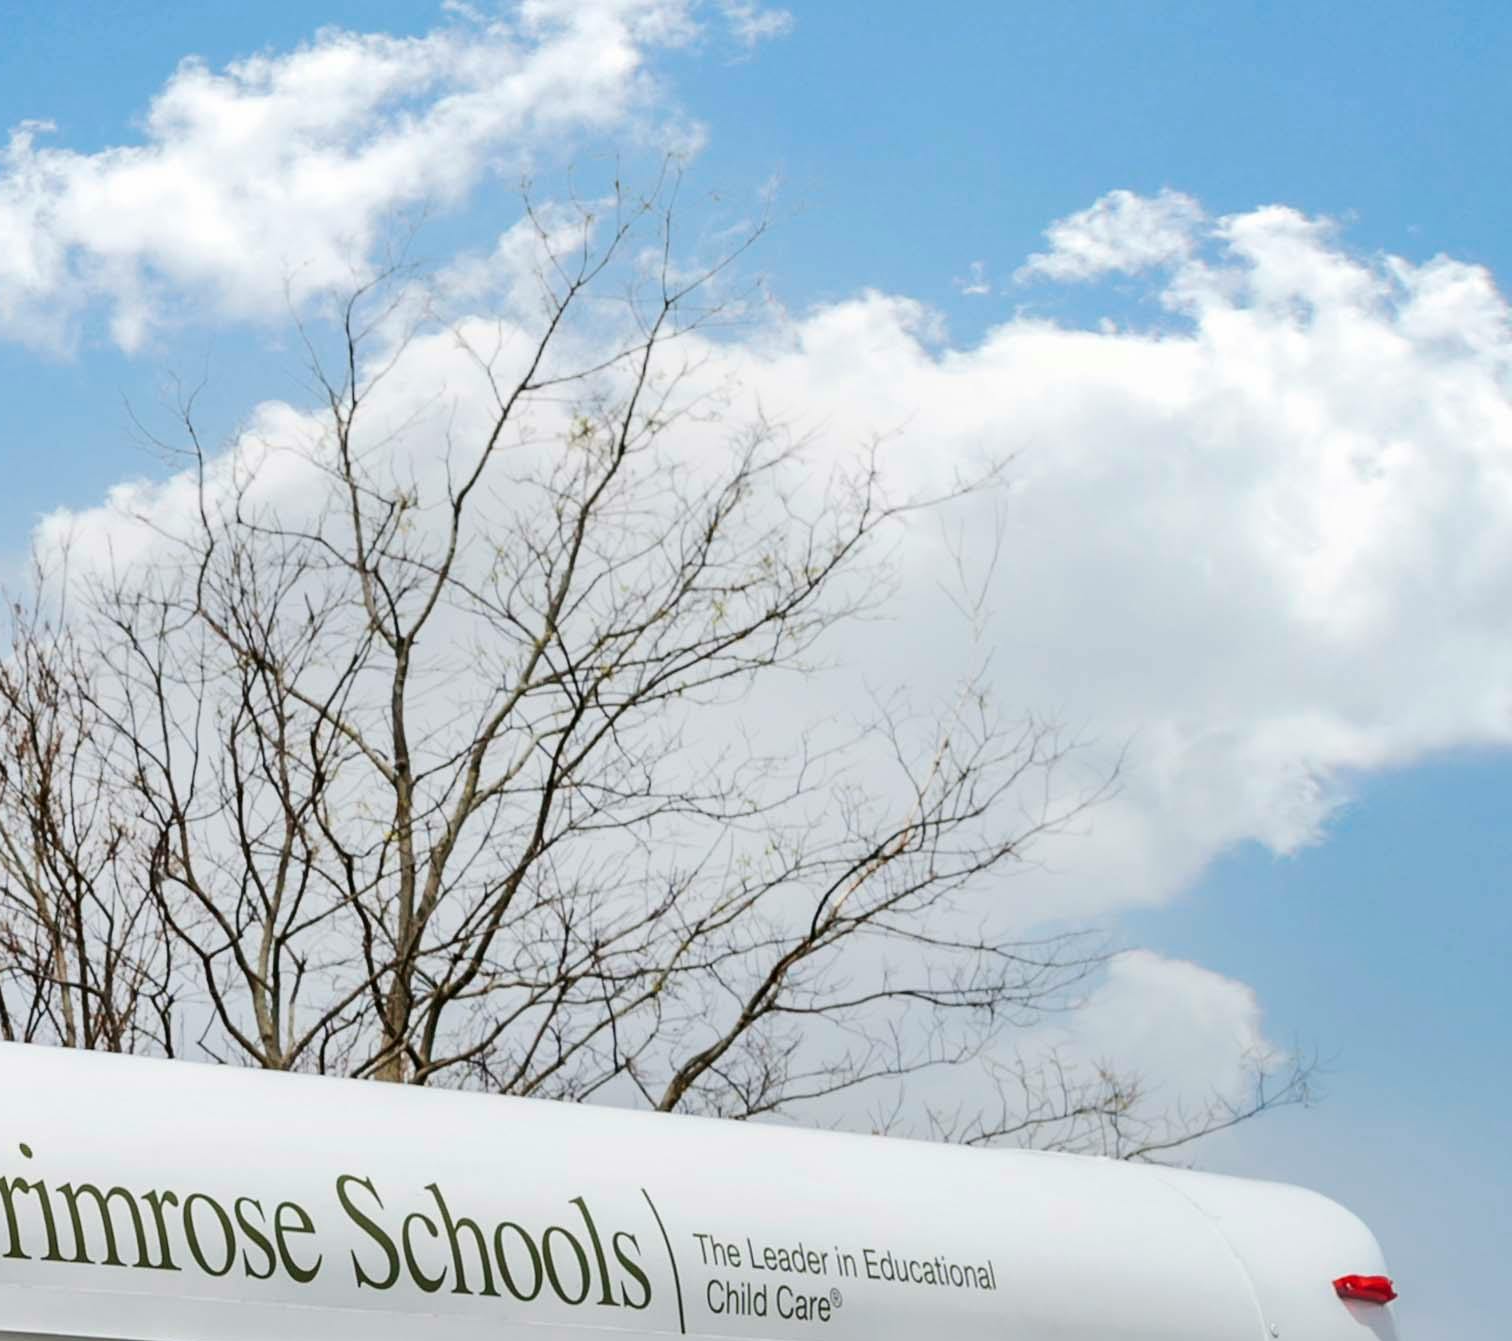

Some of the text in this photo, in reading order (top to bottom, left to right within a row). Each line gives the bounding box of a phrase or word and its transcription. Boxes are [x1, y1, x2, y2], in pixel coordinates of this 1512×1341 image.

[336, 1174, 652, 1310] Schools
[692, 1232, 997, 1291] The Leader in Educational
[706, 1279, 768, 1318] Child
